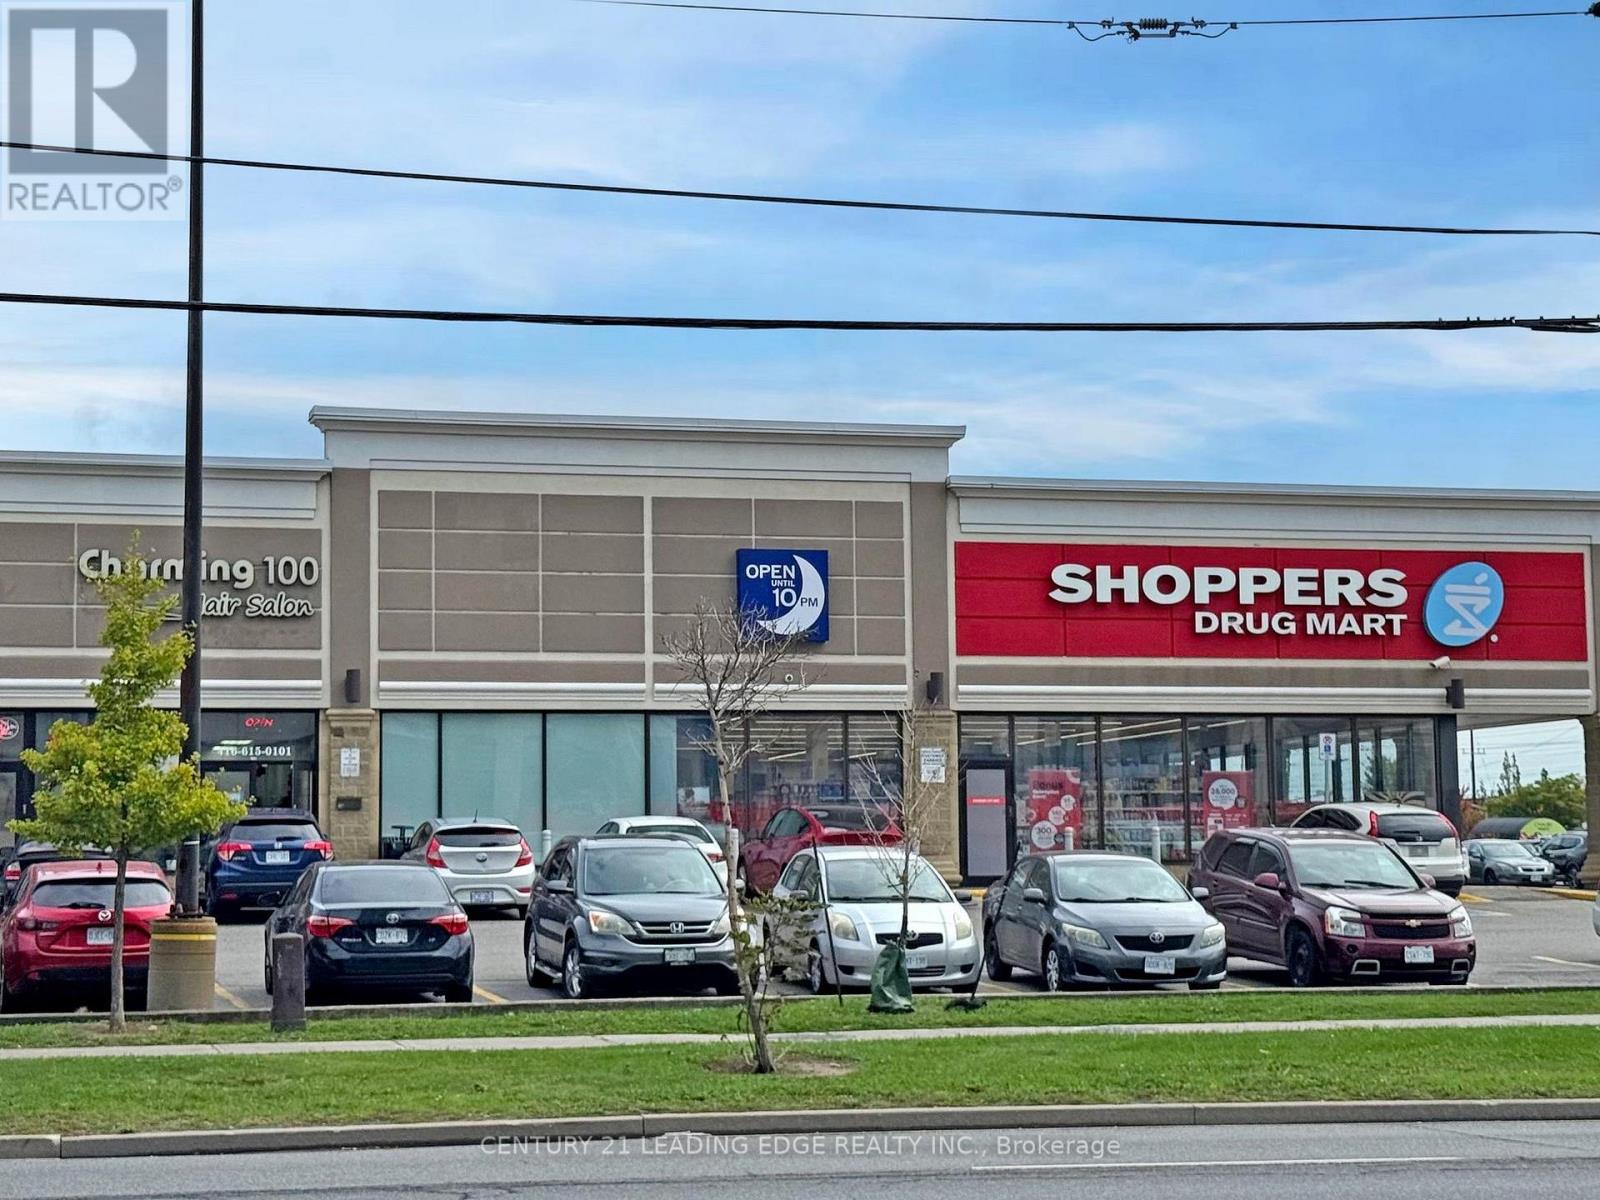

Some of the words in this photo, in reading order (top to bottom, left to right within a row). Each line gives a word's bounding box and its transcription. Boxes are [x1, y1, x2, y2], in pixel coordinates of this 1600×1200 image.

[263, 556, 320, 586] 100
[745, 564, 796, 579] OPEN
[771, 580, 796, 588] UNTIL
[772, 588, 798, 608] 10
[800, 597, 819, 608] PM
[1048, 563, 1409, 608] SHOPPERS
[200, 592, 242, 616] air
[245, 591, 315, 617] Salon
[1194, 611, 1298, 636] DRUG
[1306, 612, 1409, 637] MART
